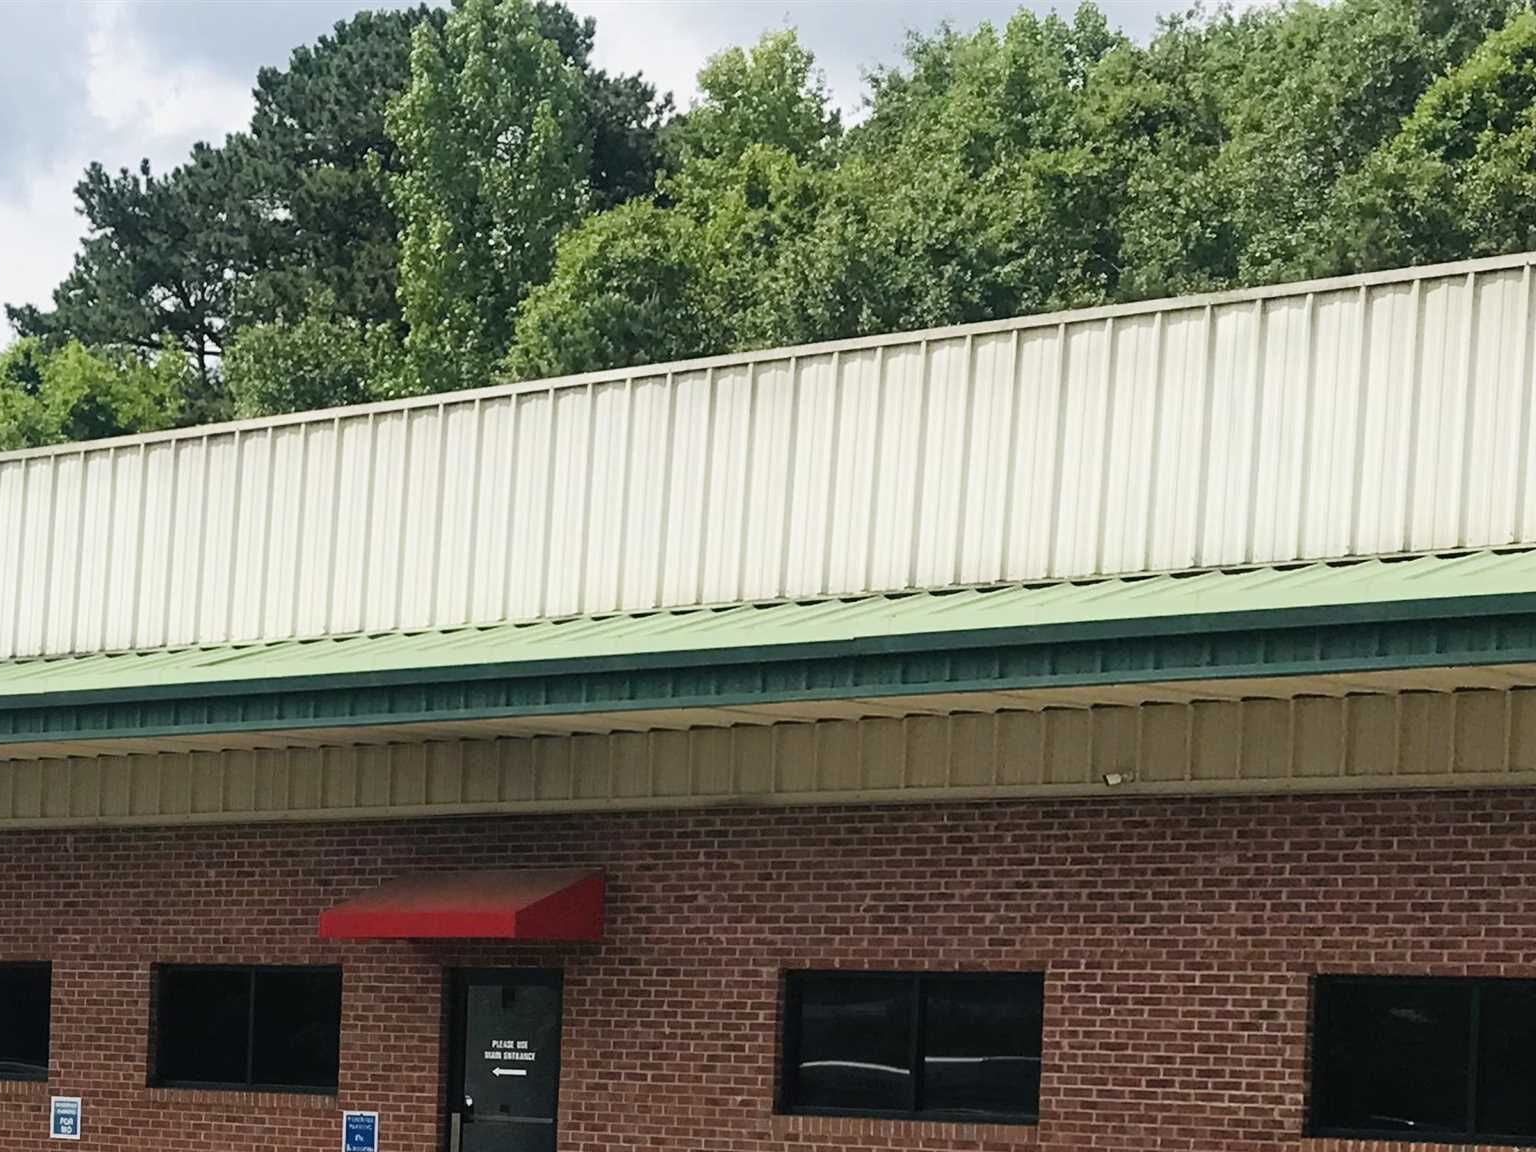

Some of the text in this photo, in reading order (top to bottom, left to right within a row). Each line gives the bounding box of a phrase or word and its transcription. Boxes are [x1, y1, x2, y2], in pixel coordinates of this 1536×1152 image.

[491, 1039, 529, 1050] PLEASE USE
[503, 1051, 536, 1062] ENTRANCE
[59, 1116, 74, 1126] FOR
